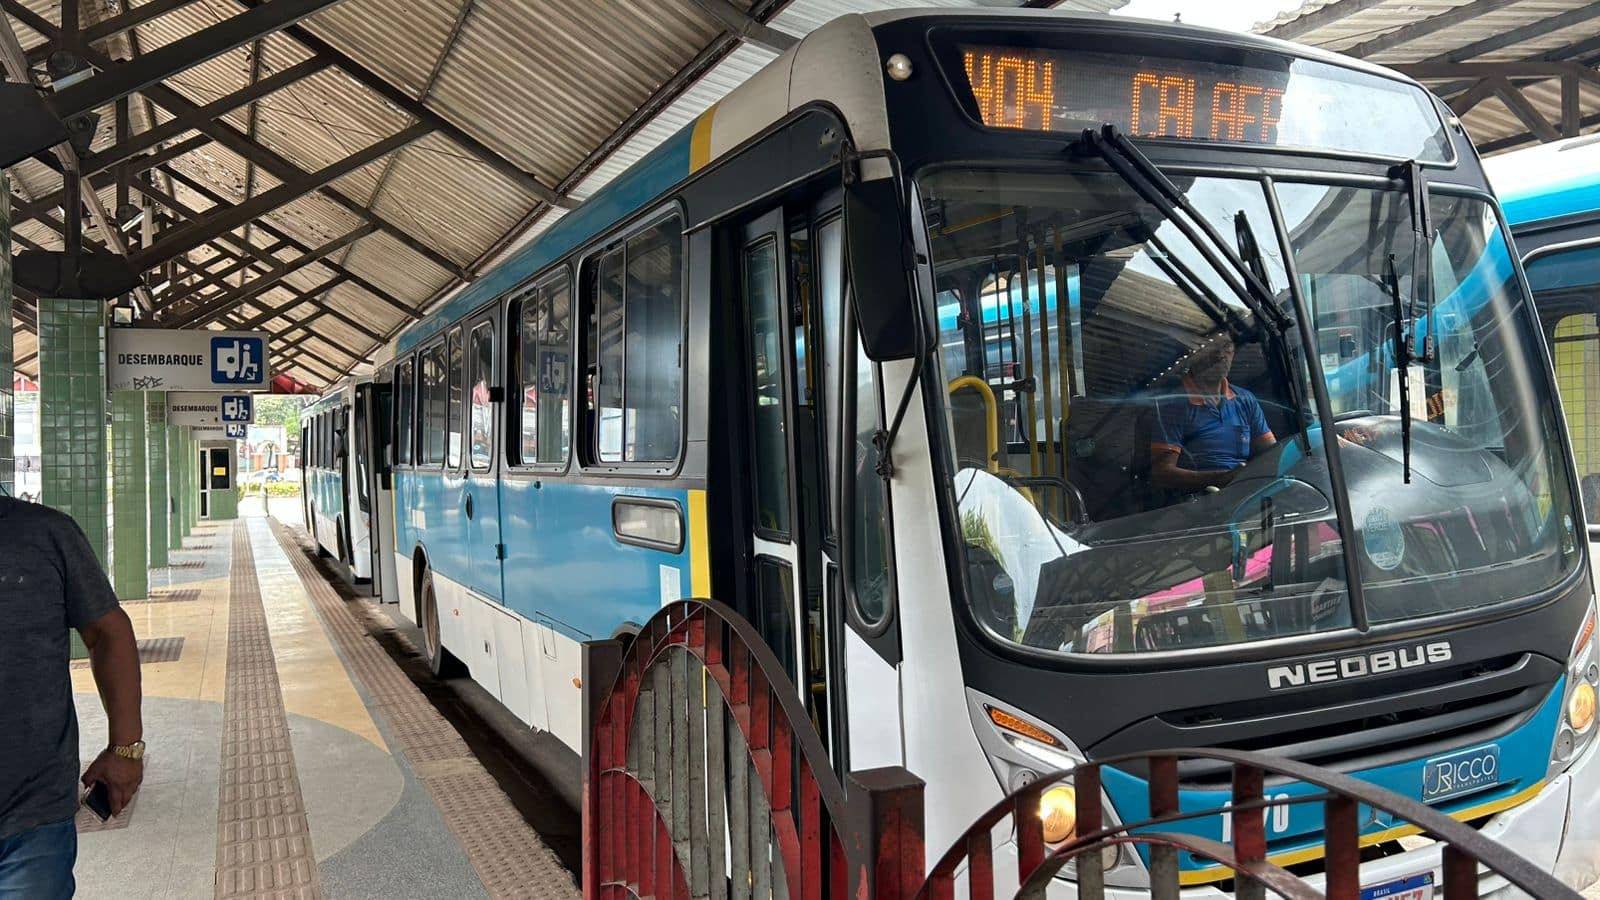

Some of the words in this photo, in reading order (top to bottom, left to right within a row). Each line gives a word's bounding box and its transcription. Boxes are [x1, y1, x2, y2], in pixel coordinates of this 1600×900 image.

[964, 52, 1054, 131] 404
[118, 353, 203, 366] DESEMBARQUE
[1267, 641, 1452, 689] NEOBUS
